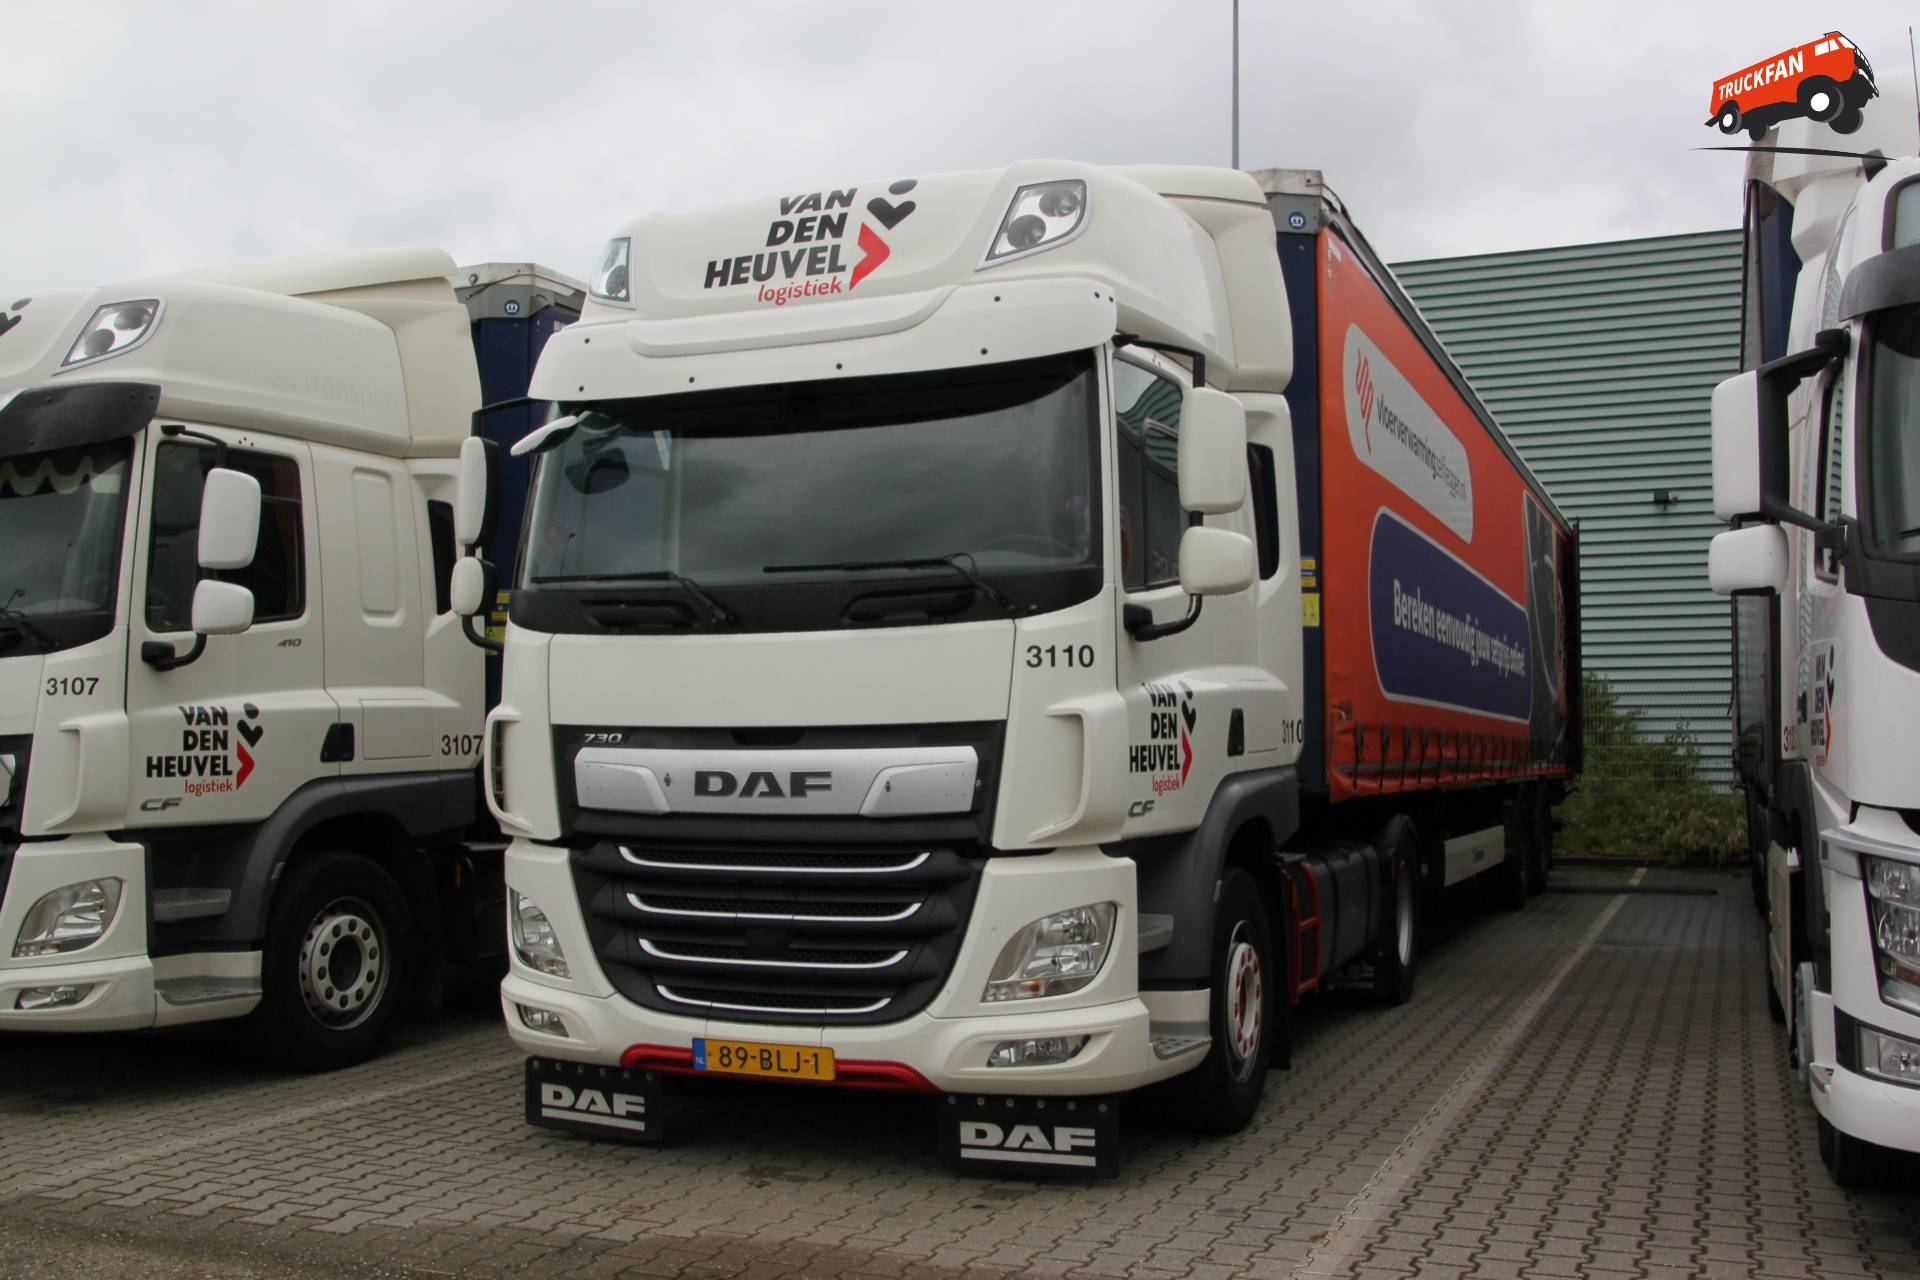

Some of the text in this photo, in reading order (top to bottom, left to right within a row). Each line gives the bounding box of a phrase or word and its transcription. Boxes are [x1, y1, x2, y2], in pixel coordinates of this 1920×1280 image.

[779, 187, 858, 216] VAN
[765, 212, 848, 248] DEN
[703, 243, 847, 289] HEUVEL
[757, 275, 842, 306] logistiek
[1393, 578, 1435, 640] Bereken
[277, 638, 302, 647] 410
[1026, 644, 1095, 668] 3110
[46, 677, 100, 696] 3107
[1142, 682, 1178, 708] VAN
[178, 705, 229, 726] VAN
[1150, 712, 1178, 740] DEN
[182, 729, 229, 752] DEN
[441, 734, 484, 756] 3107
[583, 733, 623, 744] 730
[1281, 719, 1303, 745] 3110
[145, 754, 233, 778] HEUVEL
[1129, 744, 1181, 773] HEUVEL
[184, 778, 233, 797] logistiek
[693, 770, 833, 799] DAF
[1152, 773, 1181, 797] logistiek
[139, 796, 184, 812] CF
[1127, 799, 1156, 818] CF
[719, 1045, 820, 1075] 89-BLJ-1
[541, 1082, 646, 1117] DAF
[959, 1120, 1097, 1152] DAF
